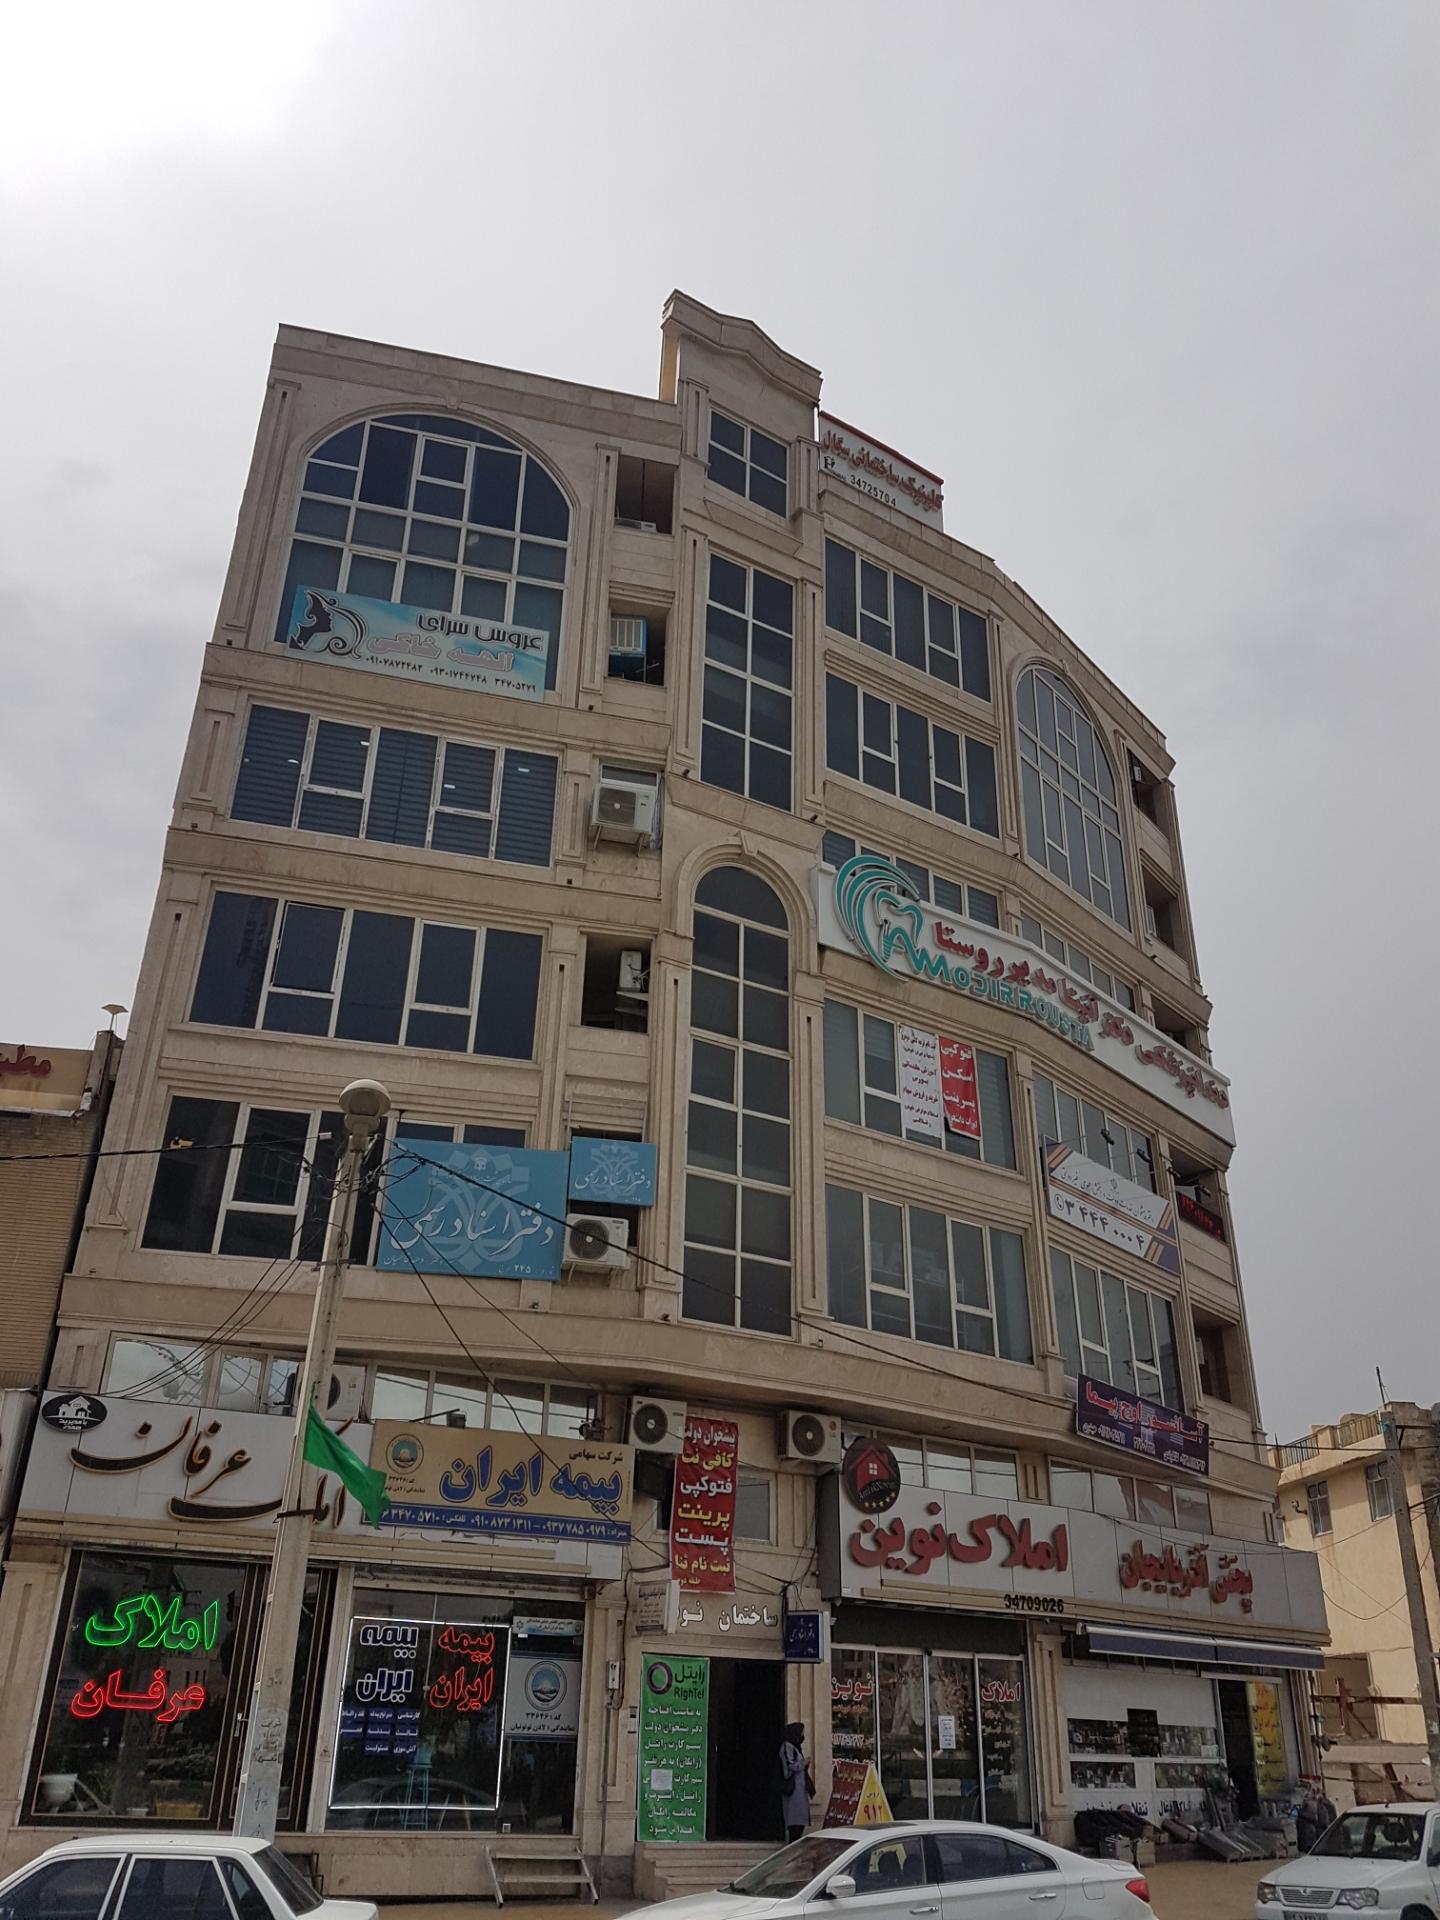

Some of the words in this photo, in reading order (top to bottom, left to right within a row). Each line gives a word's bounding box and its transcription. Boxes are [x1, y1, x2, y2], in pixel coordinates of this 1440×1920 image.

[850, 474, 897, 507] 34725704
[416, 612, 470, 637] سرای
[474, 624, 544, 651] عروس
[940, 1043, 977, 1062] فتوکپی
[621, 1167, 652, 1194] دفتر
[389, 1203, 446, 1251] رسمی
[448, 1210, 511, 1242] اسناد
[488, 1201, 555, 1258] دفتر
[69, 1415, 252, 1499] عرفان
[568, 1447, 596, 1462] سهامی
[596, 1450, 625, 1465] شرکت
[681, 1449, 700, 1465] نت
[702, 1452, 734, 1471] کافی
[438, 1444, 544, 1508] ایران
[549, 1460, 623, 1516] بیمه
[679, 1476, 734, 1498] فتوکپی
[677, 1501, 731, 1531] پرینت
[674, 1527, 730, 1555] پست
[849, 1500, 948, 1575] نوین
[950, 1513, 1069, 1572] املاک
[690, 1554, 707, 1573] نام
[710, 1558, 731, 1573] ثبت
[1119, 1538, 1210, 1598] آذربایجان
[718, 1602, 779, 1632] ساختمان
[1003, 1593, 1065, 1615] 34709026
[84, 1591, 221, 1652] املاک
[359, 1623, 420, 1659] بیمه
[437, 1625, 496, 1664] بیمه
[355, 1667, 415, 1703] ایران
[429, 1665, 496, 1712] ایران
[674, 1662, 705, 1685] رایتل
[831, 1672, 875, 1701] نوین
[70, 1667, 207, 1723] عرفان
[673, 1684, 705, 1700] RighTel
[981, 1680, 1022, 1702] املاک
